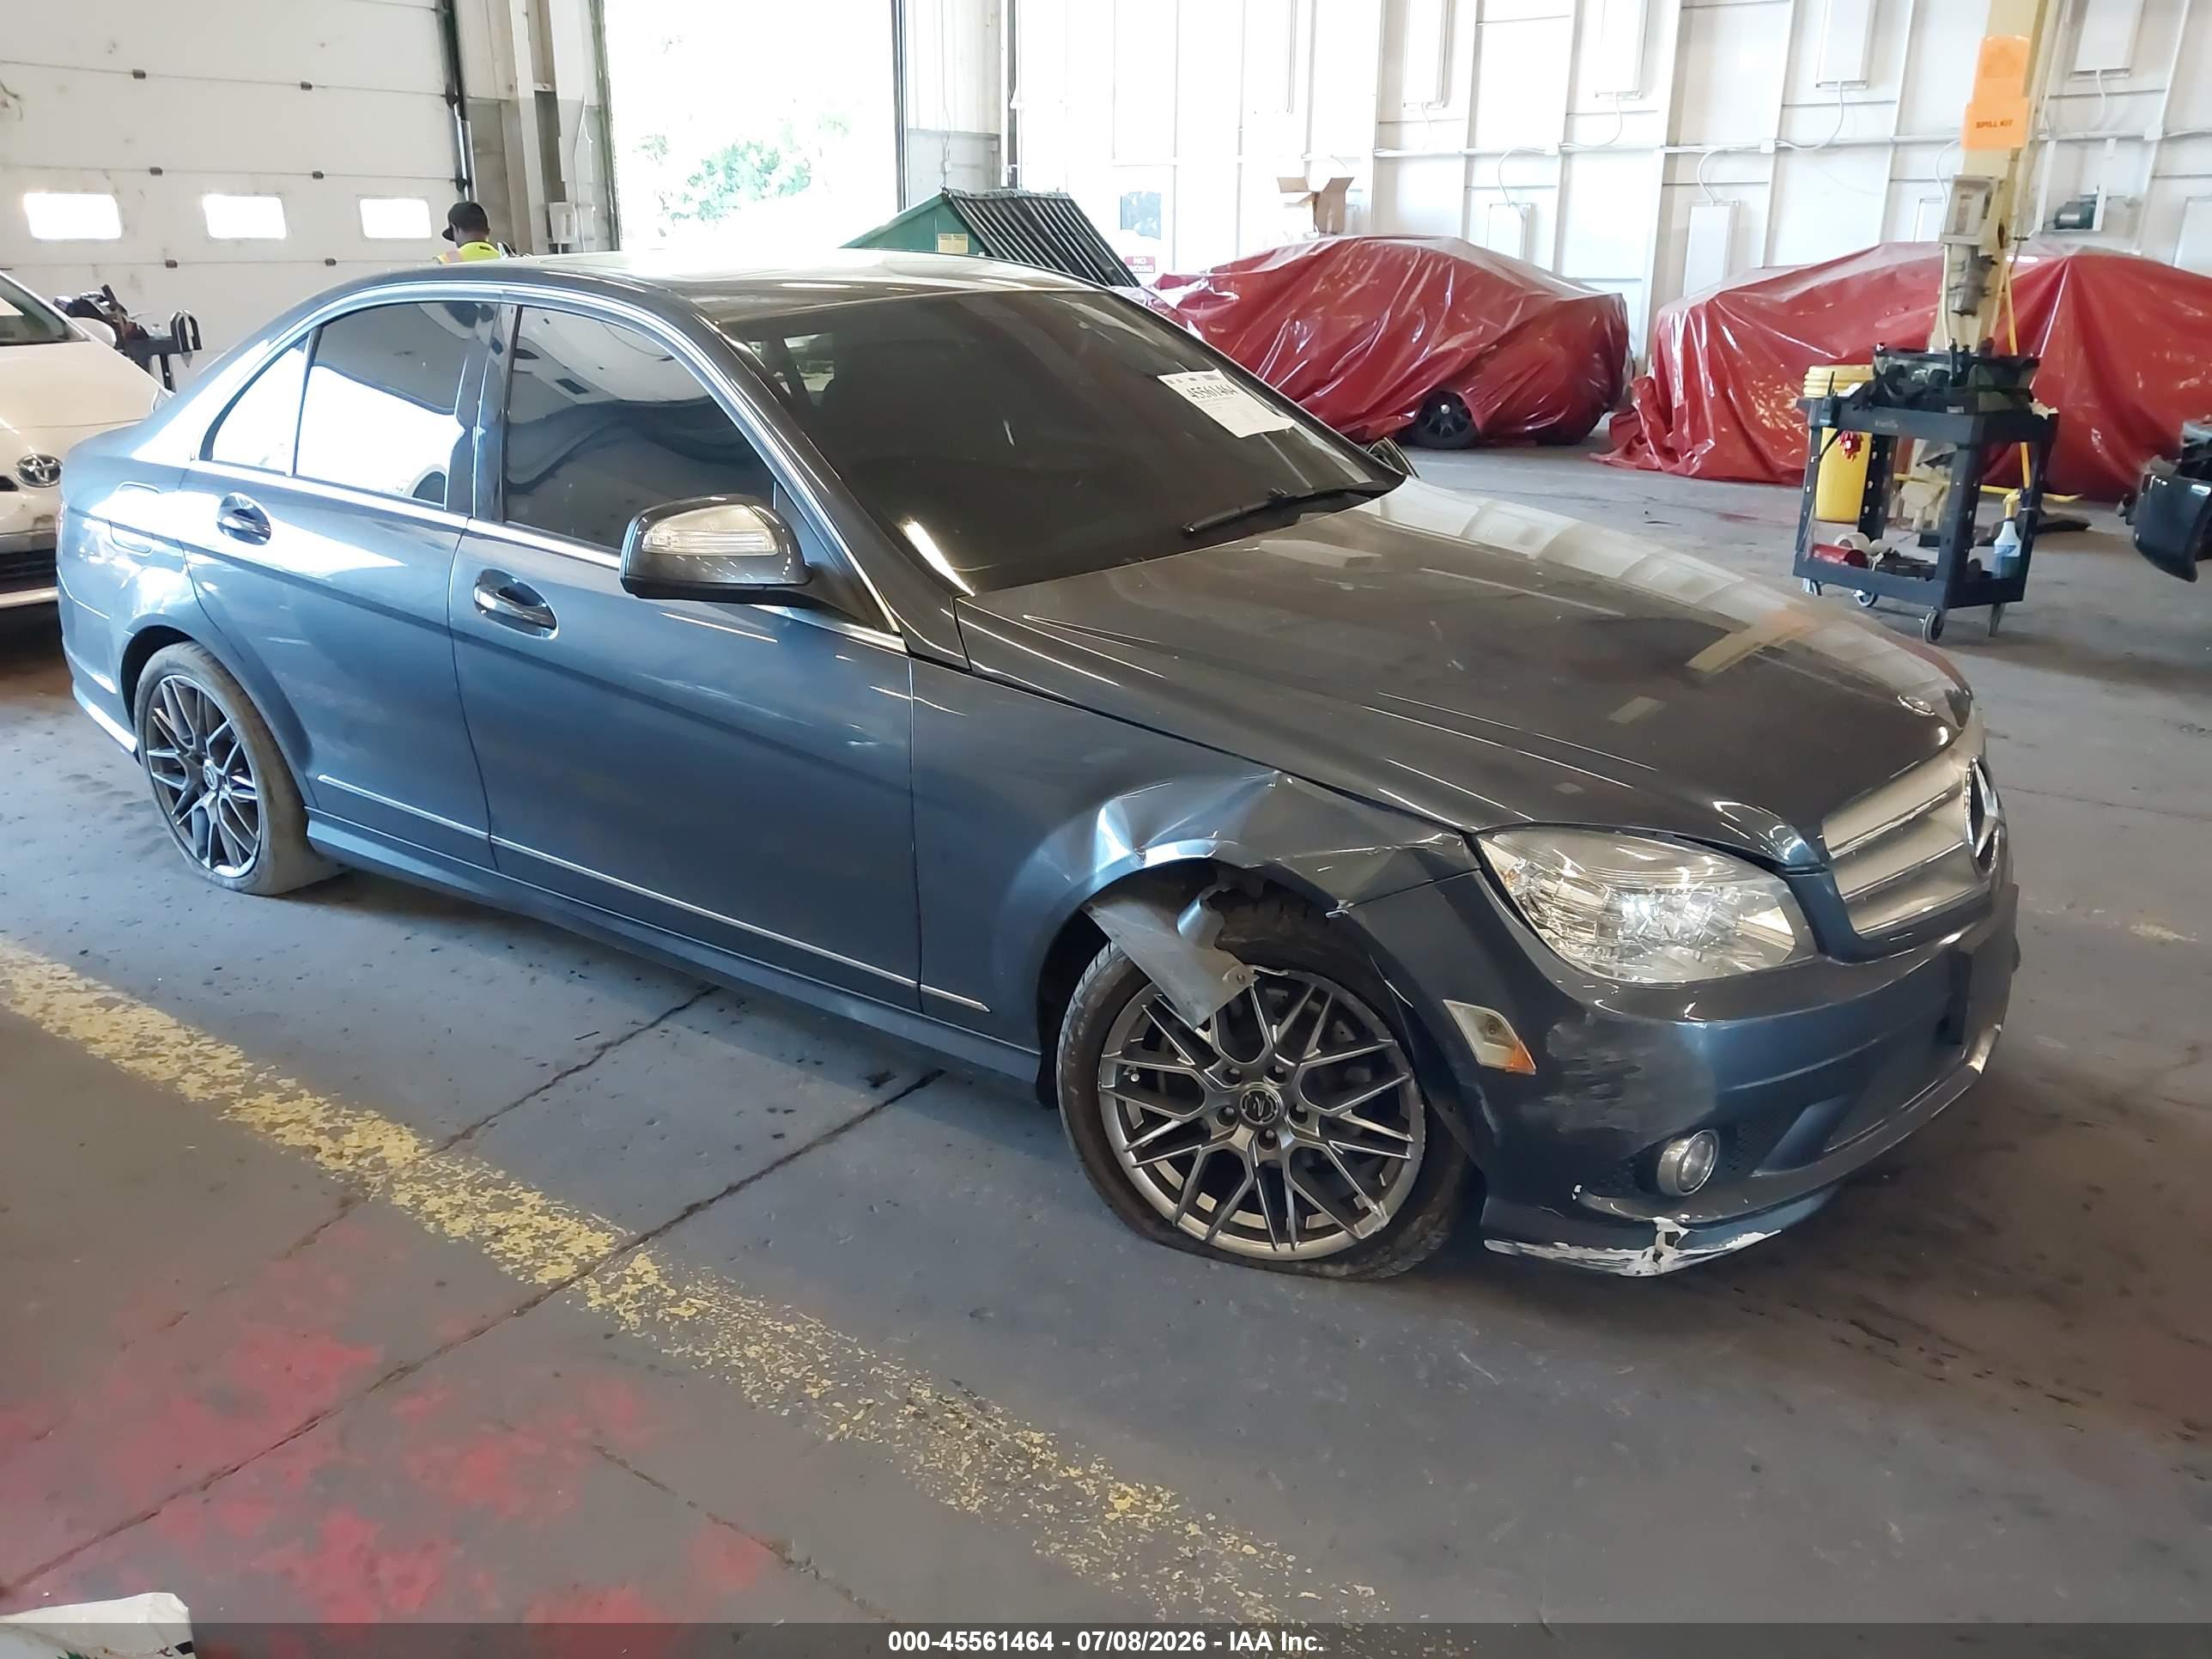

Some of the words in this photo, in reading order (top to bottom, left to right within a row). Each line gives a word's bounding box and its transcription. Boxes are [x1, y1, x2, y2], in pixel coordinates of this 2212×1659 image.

[1976, 120, 1997, 129] SPILL
[1999, 118, 2014, 127] KIT
[1186, 384, 1239, 399] 45561464
